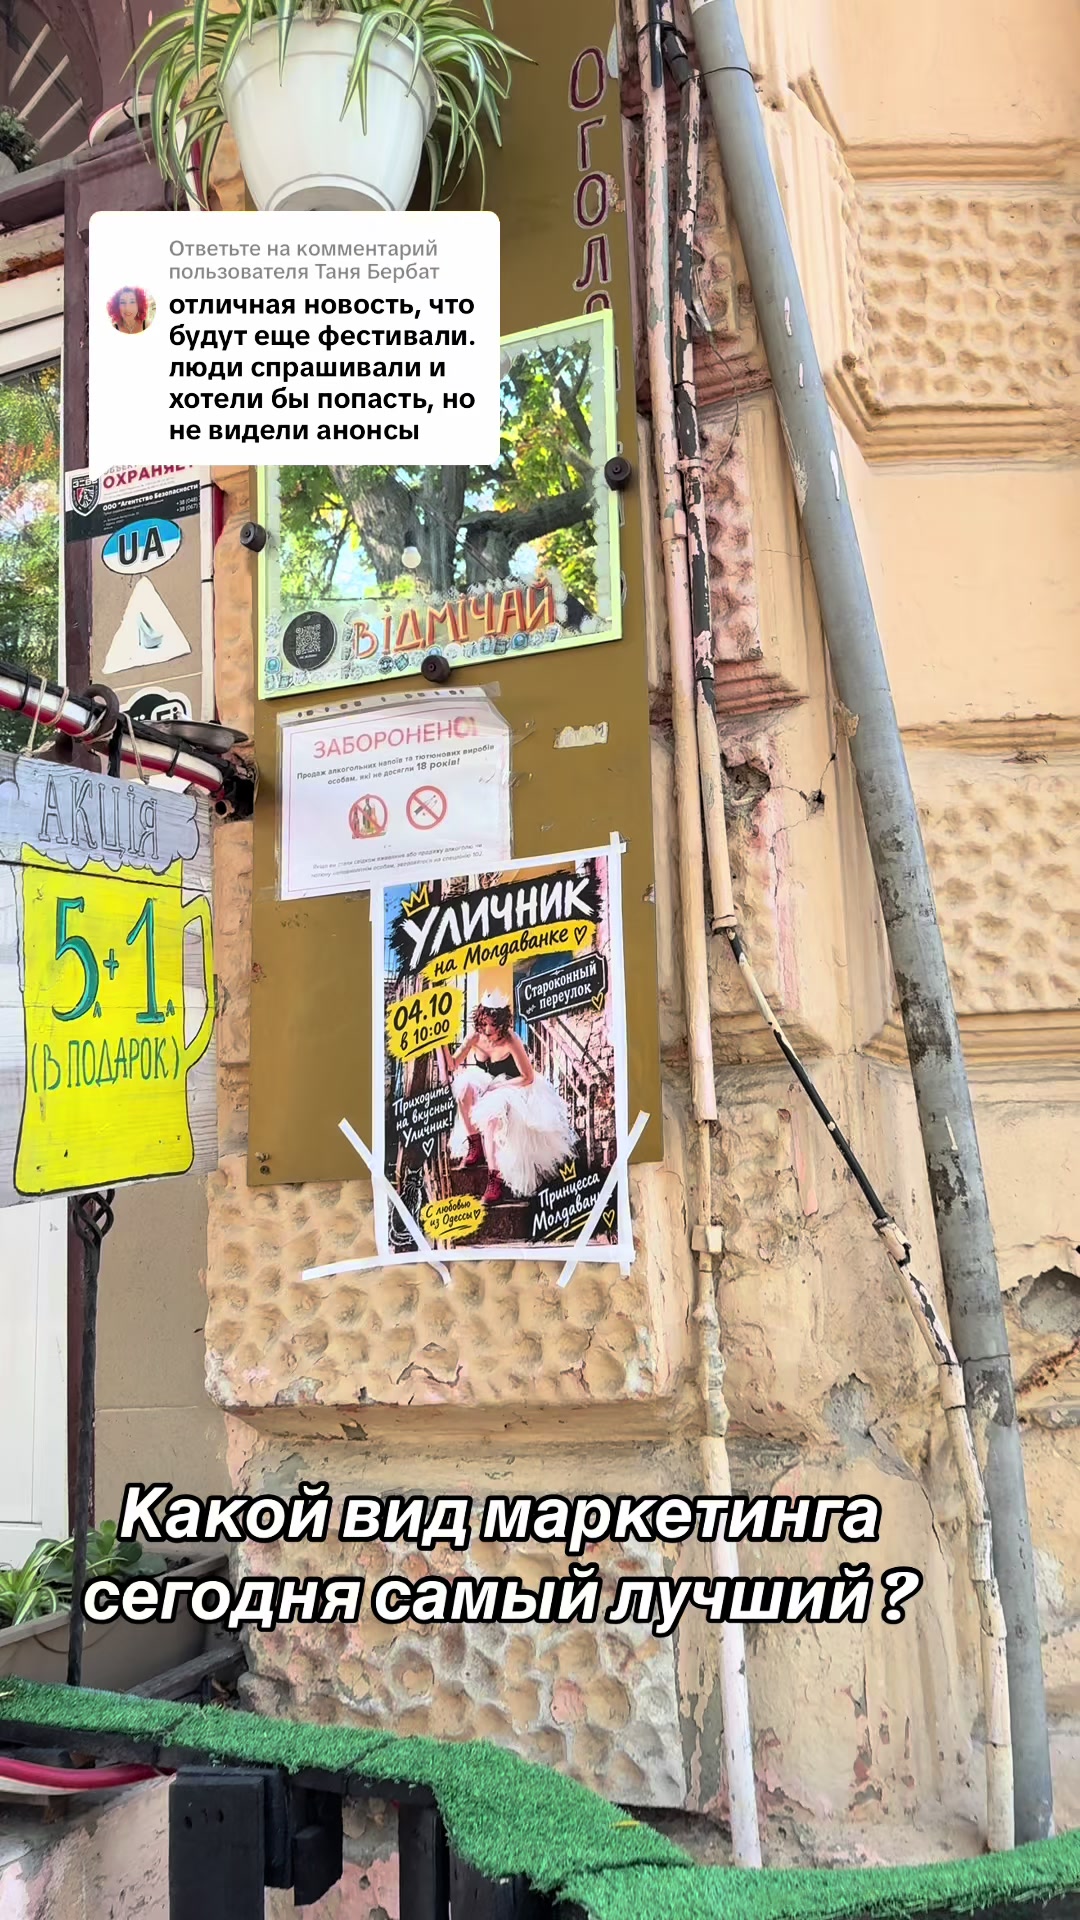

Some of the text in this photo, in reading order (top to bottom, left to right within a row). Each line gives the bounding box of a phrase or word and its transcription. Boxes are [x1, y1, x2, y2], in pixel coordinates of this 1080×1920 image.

[103, 465, 193, 489] ОХРАНЯЕ
[103, 502, 117, 511] ООО
[117, 527, 165, 566] UA
[296, 771, 326, 779] Продаж
[328, 762, 377, 775] алкогольних
[415, 750, 460, 760] тютюнових
[463, 744, 495, 755] виробів
[383, 766, 414, 777] досягли
[416, 762, 427, 771] 18
[430, 758, 460, 770] років!
[400, 878, 595, 970] УЛИЧНИК
[434, 928, 569, 977] на Молдаванке
[524, 960, 597, 1000] Староконный
[539, 983, 592, 1010] переулок
[393, 992, 453, 1031] 04.10
[400, 1019, 450, 1051] в 10:00
[392, 1085, 450, 1117] Приходите
[396, 1096, 454, 1131] на вкусный
[402, 1110, 453, 1148] Уличник!
[426, 1199, 471, 1218] С любовью
[537, 1172, 600, 1210] Принцесса
[430, 1211, 472, 1229] из Одессы
[532, 1191, 610, 1237] Молдаван
